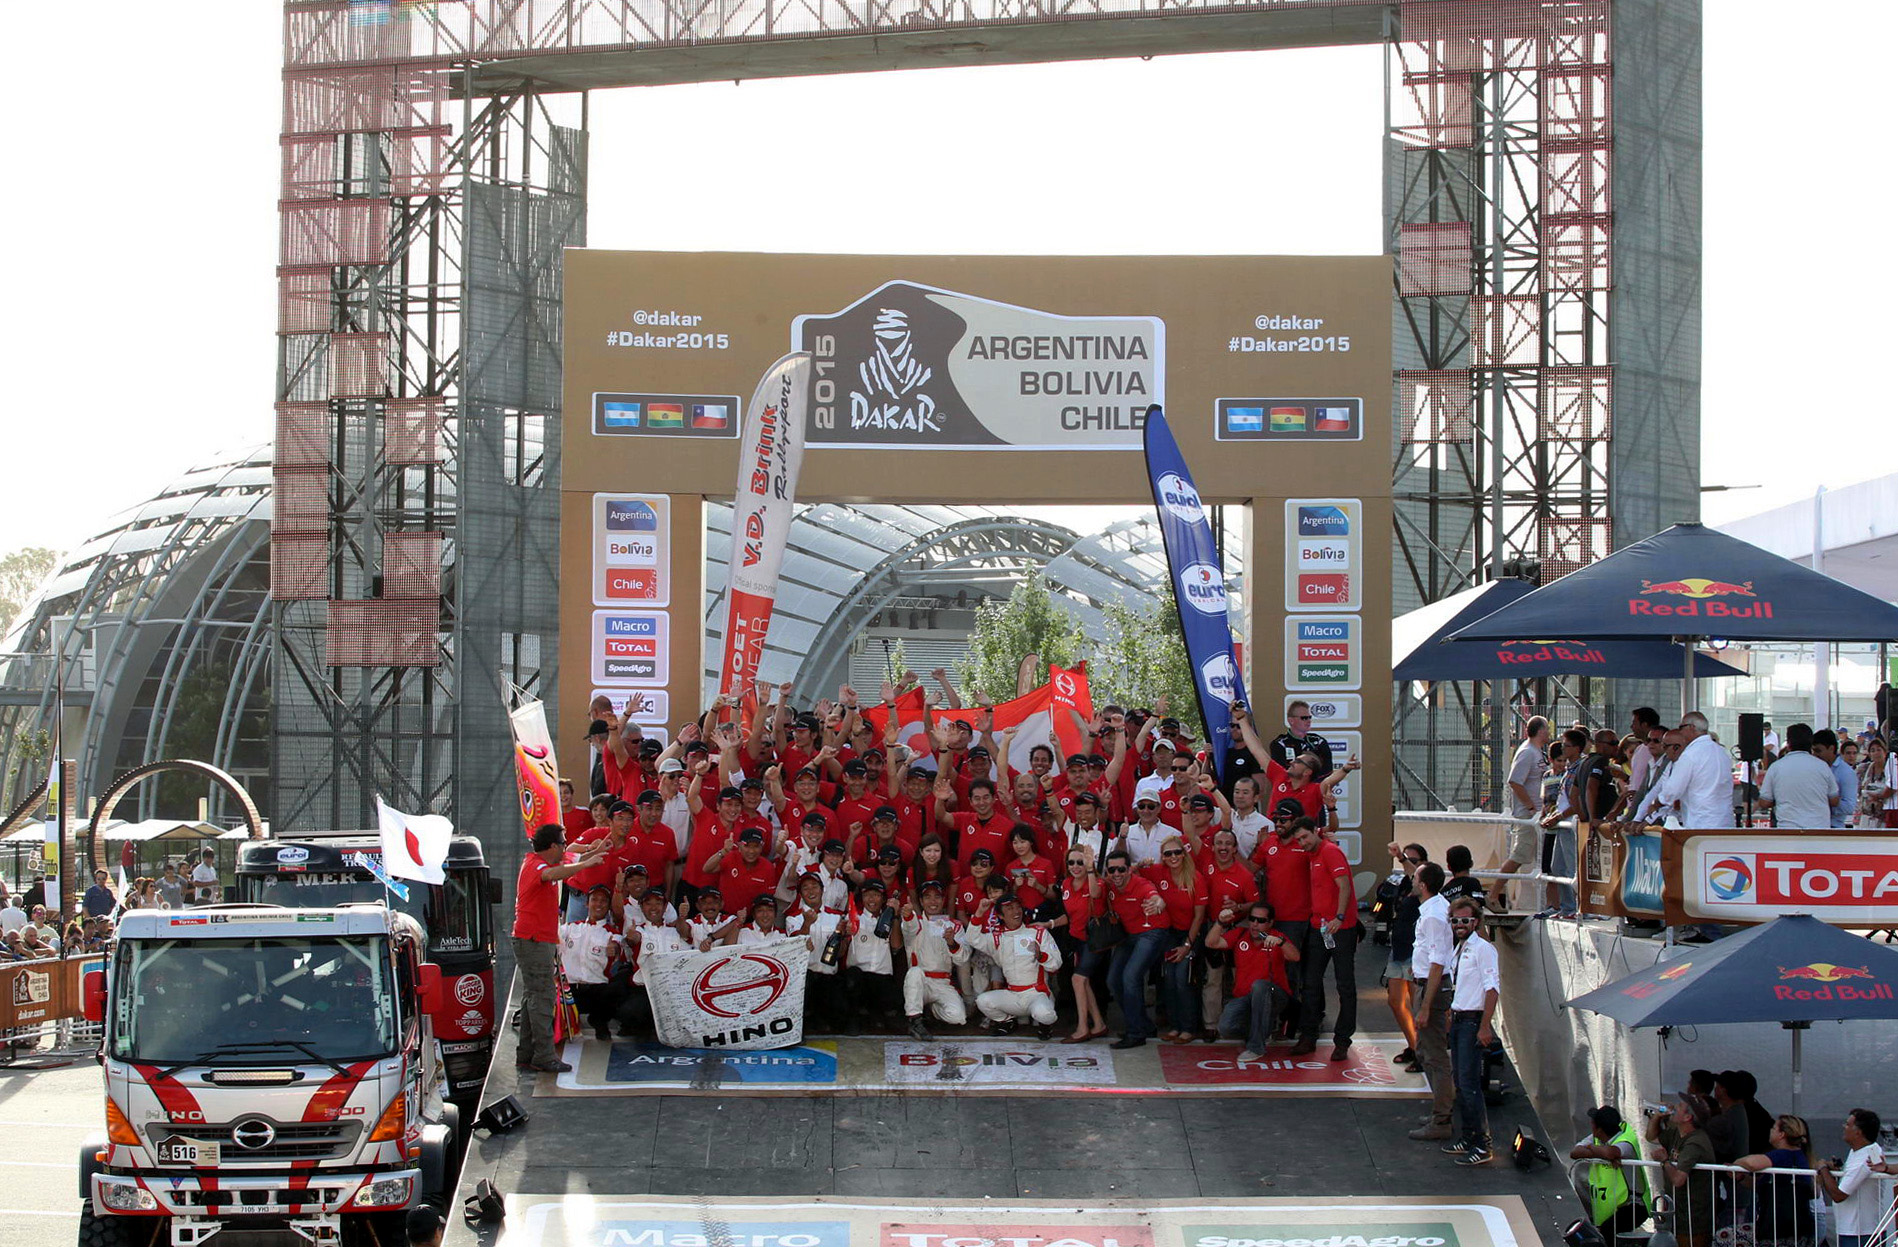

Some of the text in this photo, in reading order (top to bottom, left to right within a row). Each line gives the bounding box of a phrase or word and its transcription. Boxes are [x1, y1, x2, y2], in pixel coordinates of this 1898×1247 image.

[633, 310, 702, 328] @dakar
[1254, 314, 1324, 331] @dakar
[606, 331, 729, 350] #Dakar2015
[1228, 336, 1351, 353] #Dakar2015
[967, 335, 1149, 361] ARGENTINA
[815, 334, 836, 430] 2015
[1019, 370, 1147, 396] BOLIVIA
[849, 390, 941, 433] DAKAR
[1060, 405, 1146, 431] CHILE
[750, 402, 778, 496] Brink
[610, 510, 653, 522] Argentina
[1302, 515, 1345, 527] Argentina
[610, 541, 653, 555] Bolivia
[1302, 546, 1346, 560] Bolivia
[613, 578, 644, 590] Chile
[1305, 583, 1336, 595] Chile
[1628, 599, 1774, 619] Red Bull
[611, 620, 650, 632] Macro
[1304, 625, 1343, 636] Macro
[608, 641, 653, 653] TOTAL
[1301, 647, 1345, 657] TOTAL
[1496, 646, 1606, 665] Red Bull
[608, 663, 653, 674] SpeedAgro
[1301, 668, 1346, 678] SpeedAgro
[1315, 705, 1331, 713] FOX
[279, 852, 307, 860] eurol
[458, 979, 481, 991] BURGER
[1773, 983, 1894, 1001] Red Bull
[459, 986, 482, 999] KING
[702, 1017, 794, 1047] HINO
[628, 1054, 816, 1068] Argentina
[899, 1051, 1098, 1067] Bolivia
[1196, 1058, 1328, 1071] Chile
[145, 1109, 203, 1120] HINO
[173, 1146, 196, 1159] 516
[601, 1228, 822, 1247] Macro
